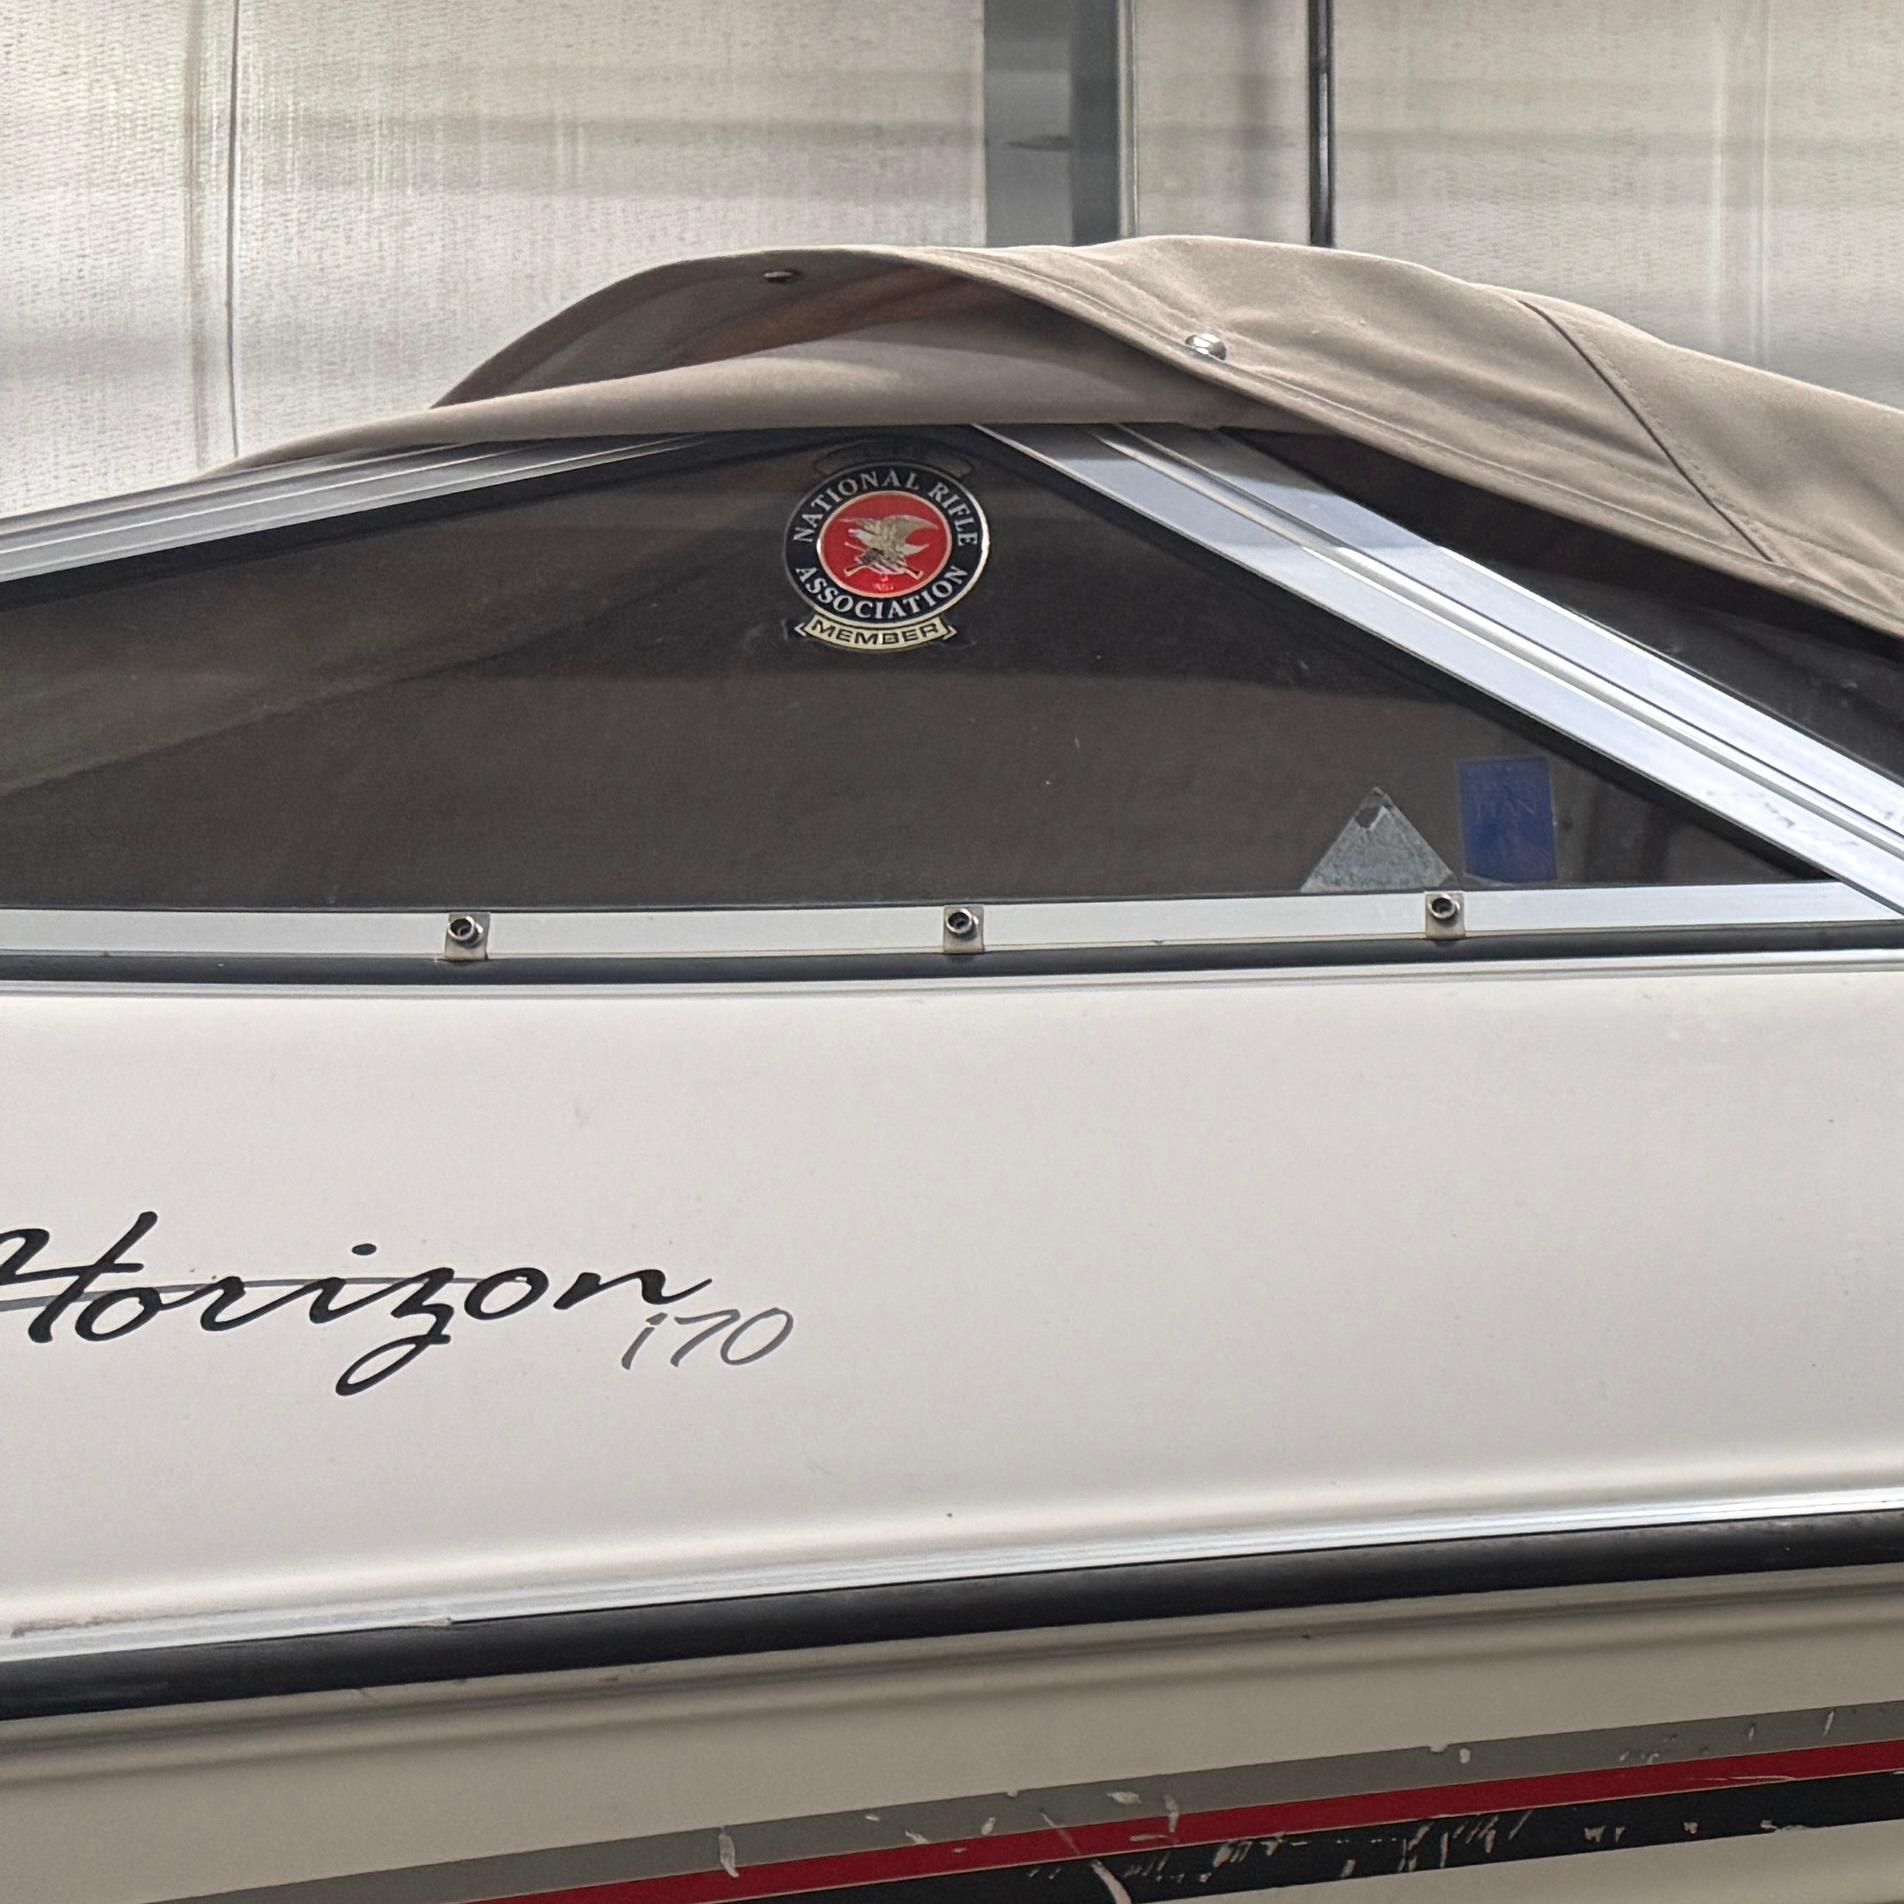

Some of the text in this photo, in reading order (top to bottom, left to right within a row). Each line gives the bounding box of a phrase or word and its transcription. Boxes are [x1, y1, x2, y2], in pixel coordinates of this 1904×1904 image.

[793, 468, 978, 547] NATIONAL RIFLE
[795, 564, 969, 620] ASSOCIATION
[811, 621, 939, 645] MEMBER
[0, 1211, 713, 1397] Horizon
